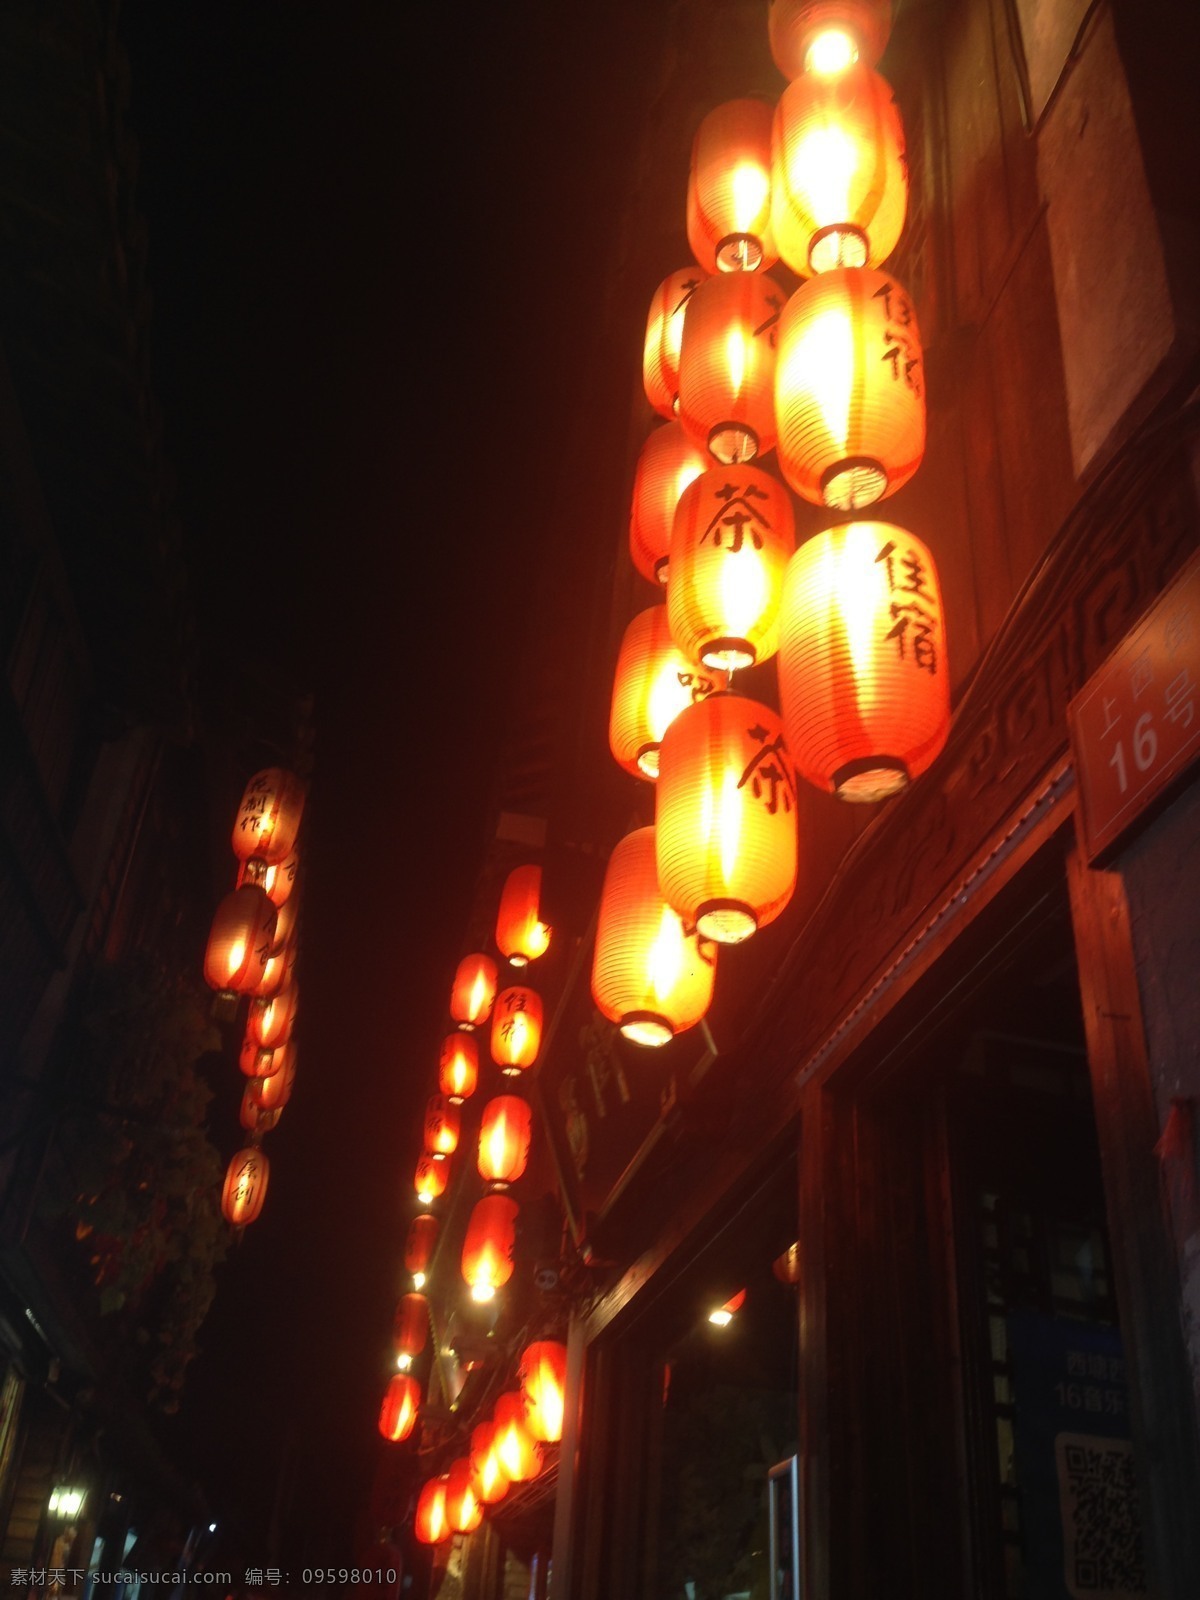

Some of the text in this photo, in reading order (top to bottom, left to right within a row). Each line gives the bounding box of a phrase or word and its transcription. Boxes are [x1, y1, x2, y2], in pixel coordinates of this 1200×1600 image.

[700, 482, 772, 552] 茶
[874, 541, 939, 676] 住宿
[737, 724, 798, 815] 茶
[1108, 667, 1197, 793] 16号
